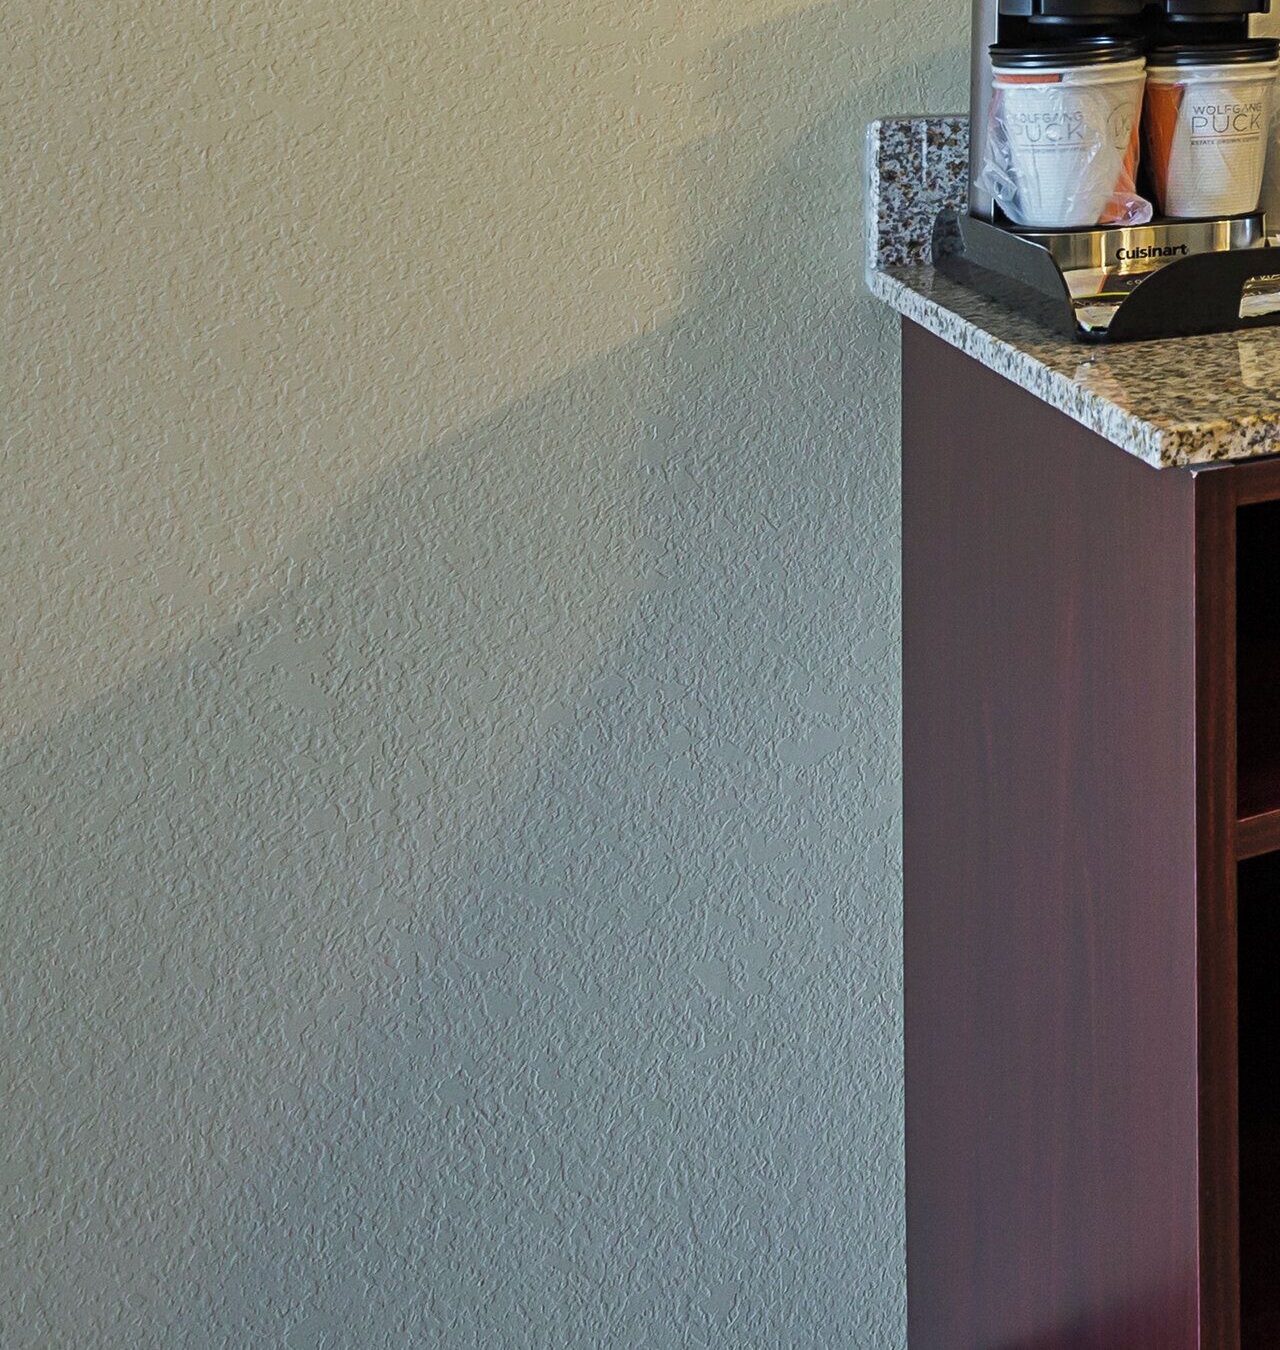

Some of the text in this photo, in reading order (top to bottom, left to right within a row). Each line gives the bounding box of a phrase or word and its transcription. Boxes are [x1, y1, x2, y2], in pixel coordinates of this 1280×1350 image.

[1007, 111, 1083, 123] WOLFGANG
[1193, 103, 1262, 115] WOLFGANG
[1009, 122, 1084, 142] PUCK
[1192, 113, 1261, 134] PUCK
[1115, 243, 1188, 261] Cuisinart
